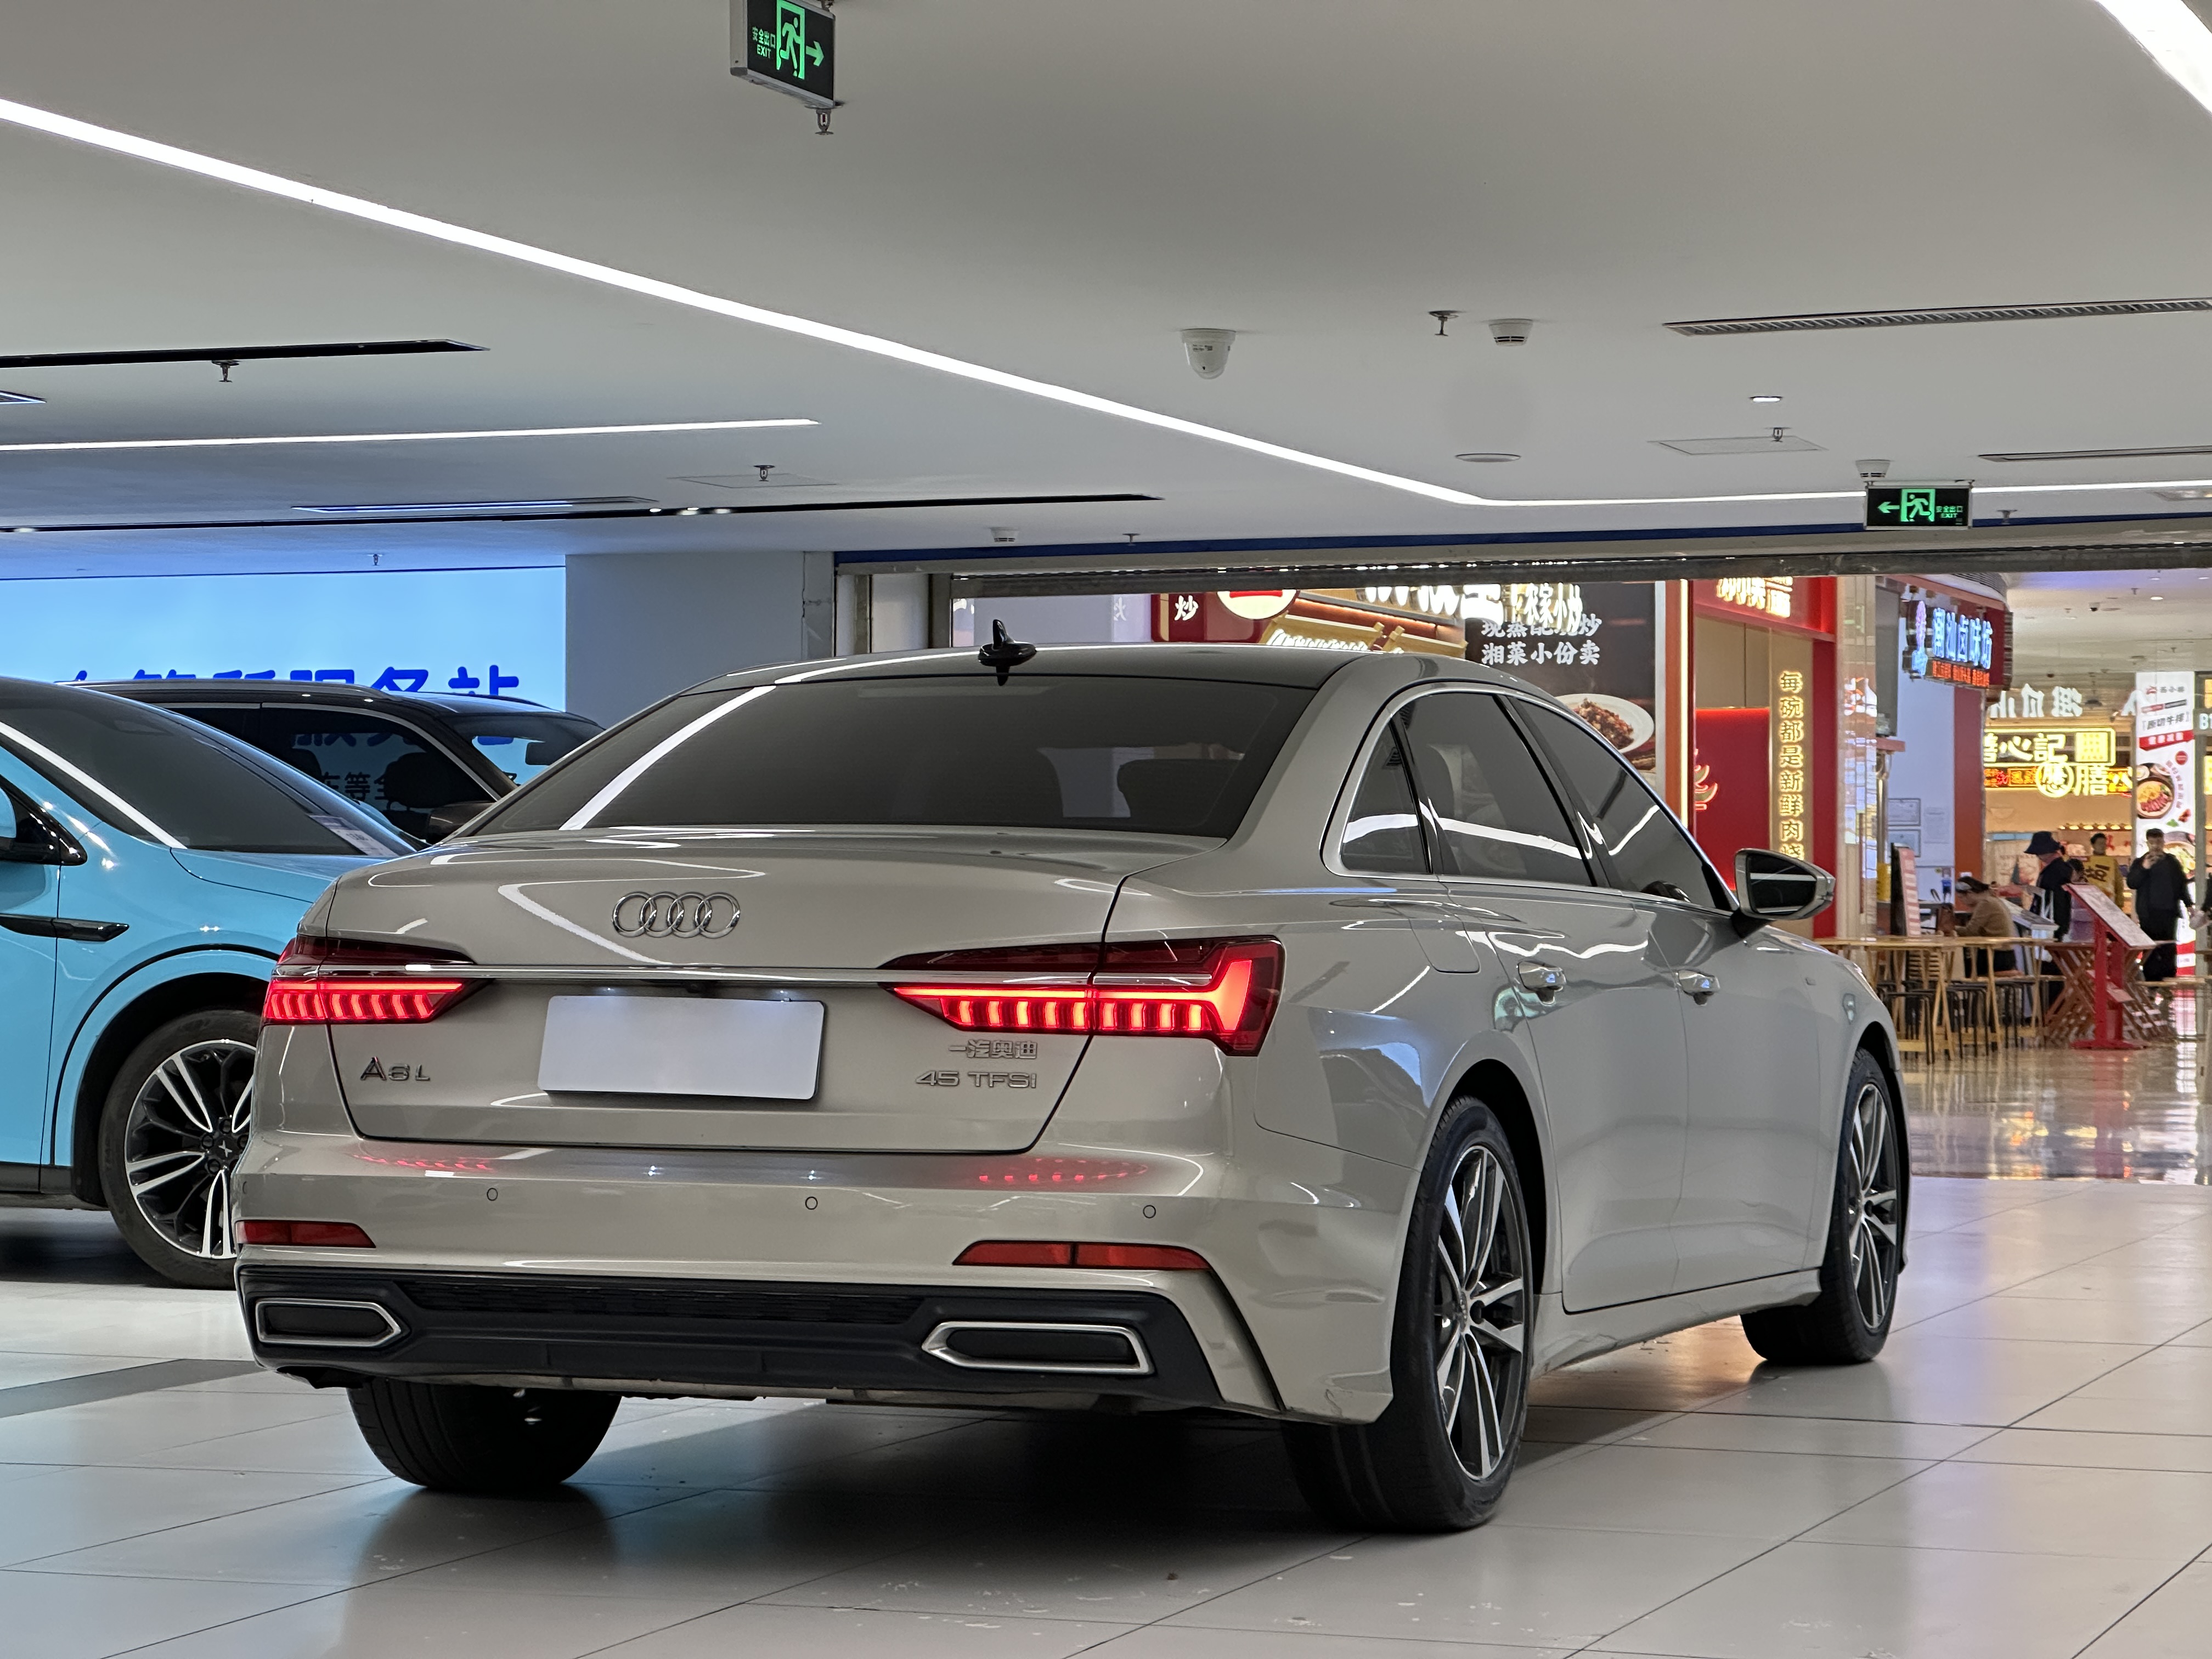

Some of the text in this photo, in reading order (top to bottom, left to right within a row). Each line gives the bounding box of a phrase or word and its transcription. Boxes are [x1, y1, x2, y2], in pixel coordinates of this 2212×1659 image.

[752, 27, 776, 48] 安全出口
[758, 45, 771, 58] EXIT
[1174, 595, 1199, 621] 炒
[1481, 613, 1602, 638] 现蒸炒
[1481, 639, 1600, 665] 湘菜小份卖
[949, 1039, 1038, 1059] 一汽奥迪
[916, 1070, 1037, 1089] 45 TFSI
